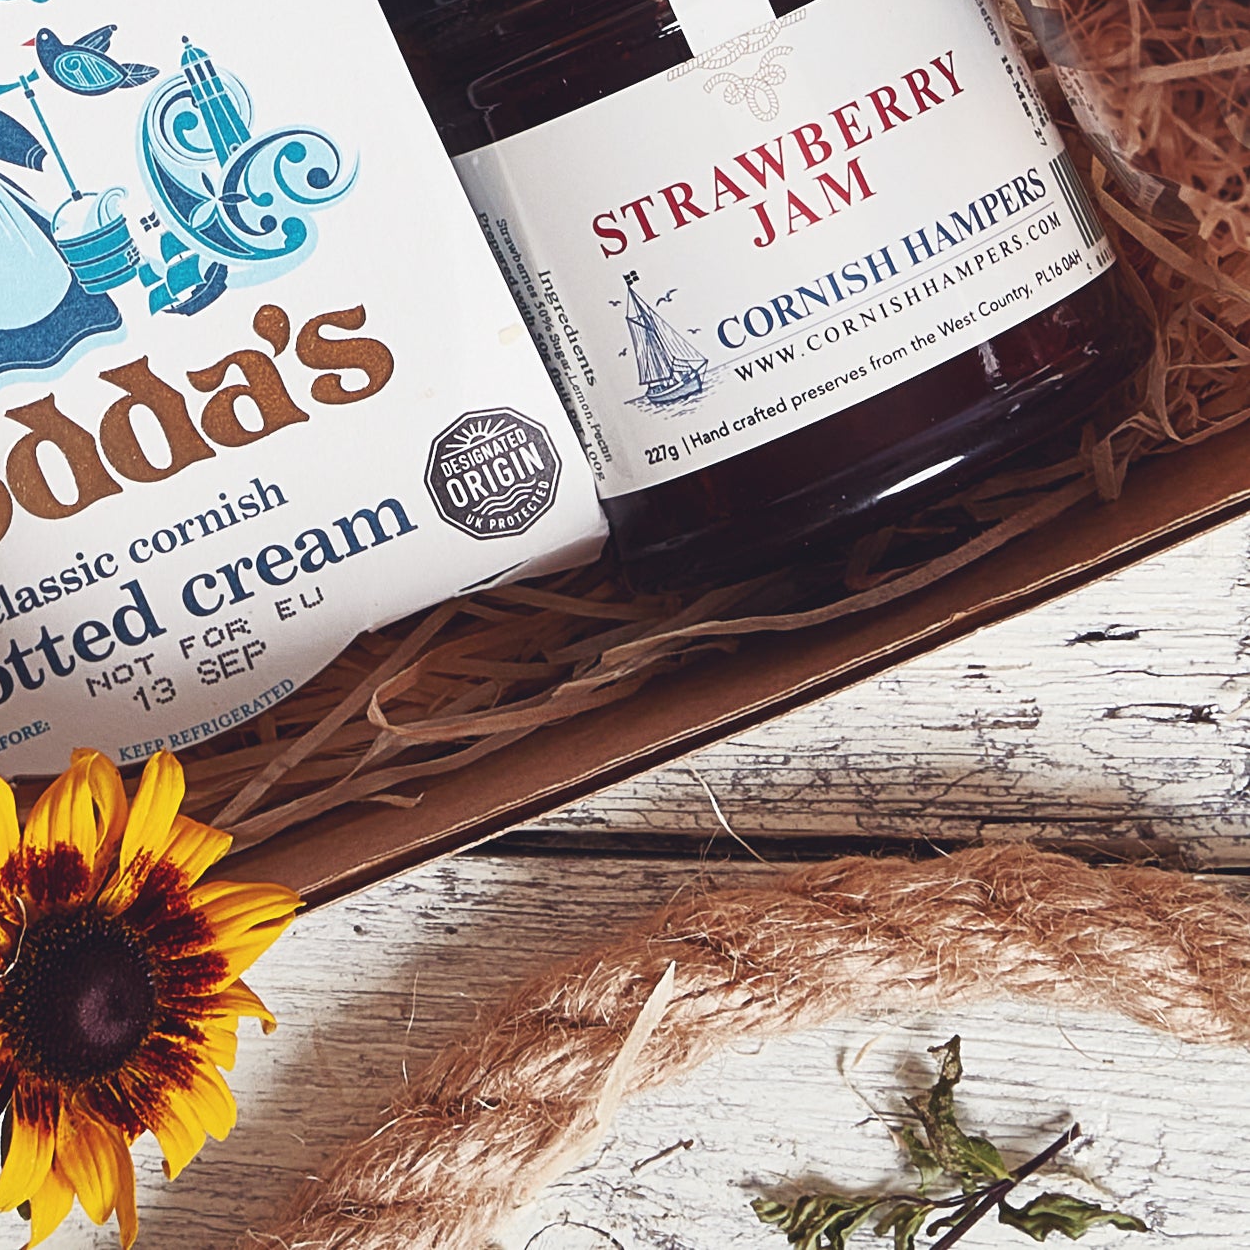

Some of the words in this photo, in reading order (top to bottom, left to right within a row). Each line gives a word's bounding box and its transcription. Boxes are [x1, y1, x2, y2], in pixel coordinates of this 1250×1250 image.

[592, 50, 970, 259] STRAWBERRY
[749, 155, 878, 251] JAM
[716, 247, 901, 350] CORNISH
[904, 166, 1049, 271] HAMPERS
[733, 210, 1063, 383] WWW.CORNISHHAMPERS.COM
[534, 299, 552, 333] 50%
[537, 269, 598, 388] Ingredients
[644, 435, 680, 466] 227g
[688, 420, 731, 450] Hand
[732, 396, 788, 433] crafted
[791, 364, 868, 412] preserves
[868, 347, 909, 372] from
[909, 330, 936, 351] the
[936, 310, 978, 338] West
[977, 283, 1034, 320] Country,
[1035, 262, 1063, 287] PL16
[512, 288, 537, 328] with
[584, 442, 606, 483] 100g
[440, 427, 528, 478] DESIGNATED
[445, 442, 545, 508] ORIGIN
[127, 476, 289, 565] cornish
[465, 513, 483, 529] UK
[489, 480, 550, 530] PROTECTED
[181, 495, 419, 619] cream
[86, 652, 157, 698] NOT
[180, 618, 253, 664] FOR
[276, 587, 325, 621] EU
[132, 676, 178, 712] 13
[196, 640, 268, 686] SEP
[118, 736, 166, 763] KEEP
[167, 678, 296, 749] REFRIGERATED
